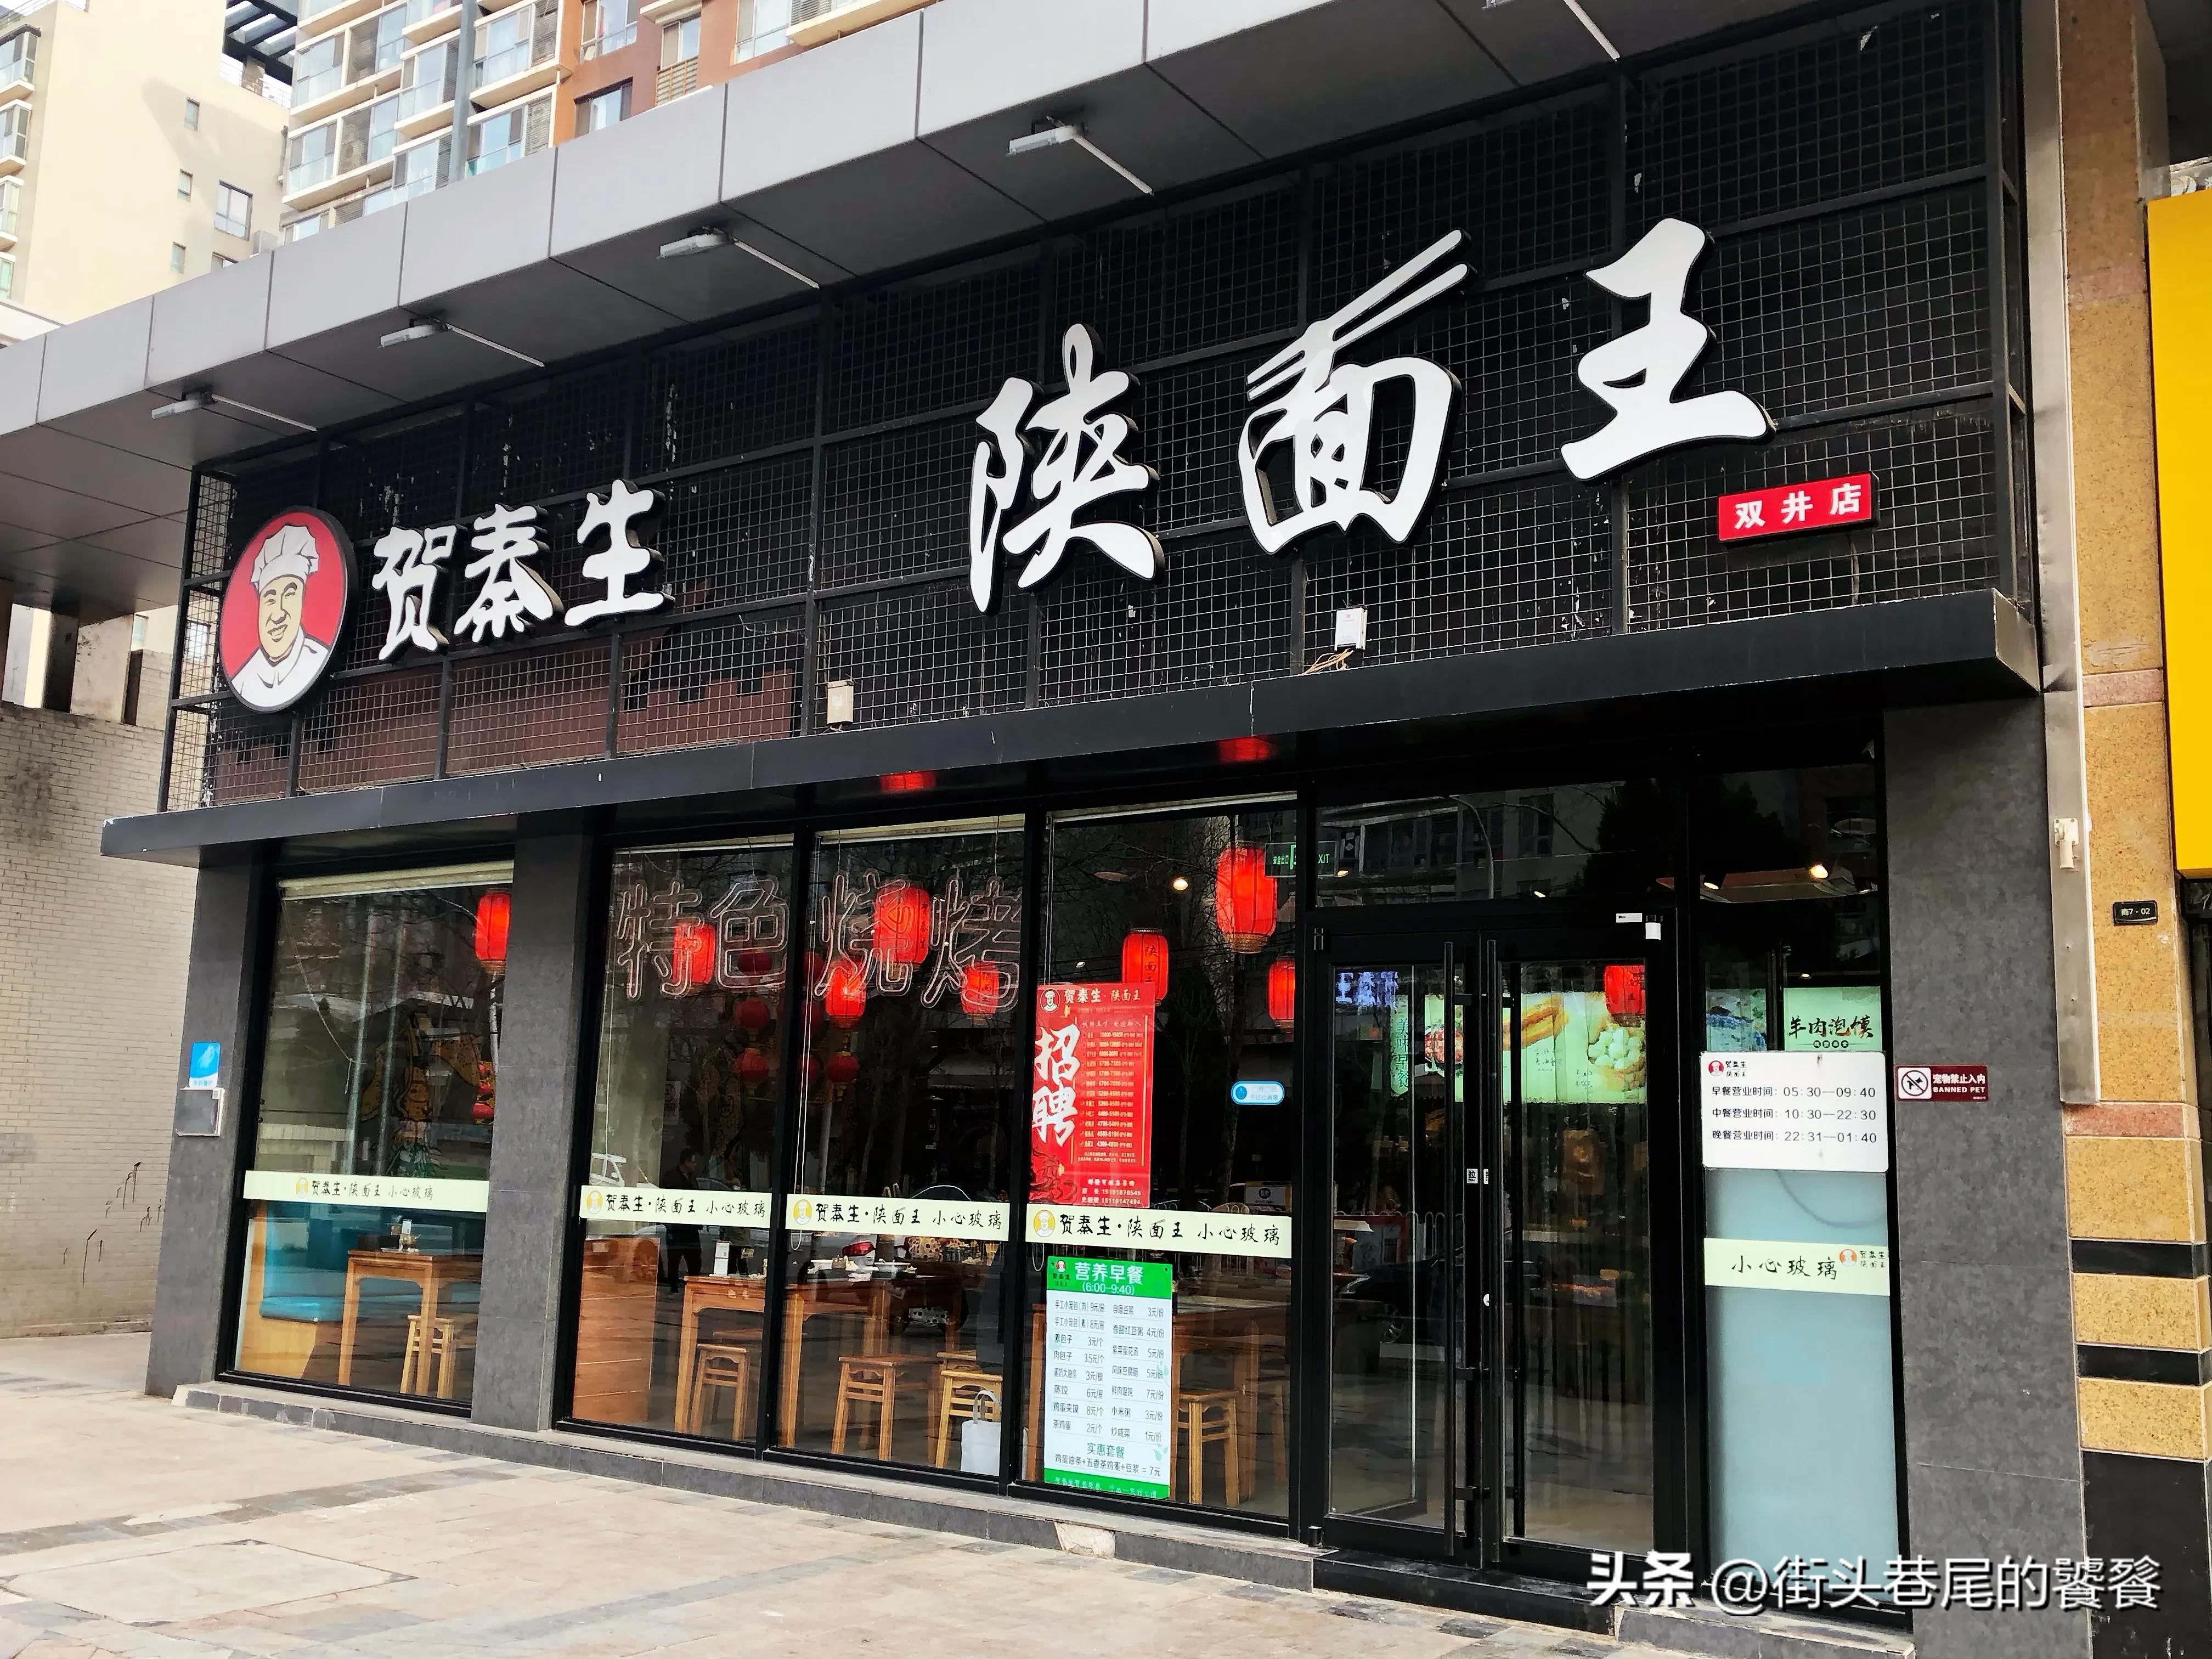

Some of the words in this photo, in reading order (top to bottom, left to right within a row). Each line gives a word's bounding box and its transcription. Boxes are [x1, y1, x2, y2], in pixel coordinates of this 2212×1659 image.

[969, 217, 1774, 614] 陕面王
[1734, 483, 1861, 530] 双井店
[617, 869, 1022, 1013] 特色烧烤
[1788, 1014, 1874, 1039] 羊肉泡馍
[1031, 1023, 1080, 1147] 招聘
[1933, 1074, 1985, 1084] 宠物禁止入内
[388, 1184, 433, 1201] 小心玻璃
[706, 1198, 766, 1218] 小心玻璃
[932, 1207, 1002, 1231] 小心玻璃
[1198, 1223, 1280, 1245] 小心玻璃
[1075, 1262, 1144, 1285] 营养早餐
[1731, 1255, 1838, 1280] 小心玻璃
[1148, 1307, 1164, 1318] 3元/份
[1147, 1328, 1164, 1339] 4元/份
[1088, 1336, 1103, 1347] 3元/个
[1054, 1351, 1073, 1361] 肉包子
[1148, 1348, 1164, 1359] 5元/份
[1147, 1368, 1163, 1379] 5元/份
[1054, 1385, 1068, 1395] 蒸饺
[1147, 1389, 1164, 1400] 7元/份
[1086, 1406, 1104, 1417] 8元/个
[1111, 1406, 1131, 1418] 小米粥
[1146, 1410, 1163, 1421] 3元/份
[1086, 1423, 1102, 1434] 2元/个
[1146, 1431, 1161, 1442] 1元/份
[1087, 1443, 1125, 1459] 实惠套餐
